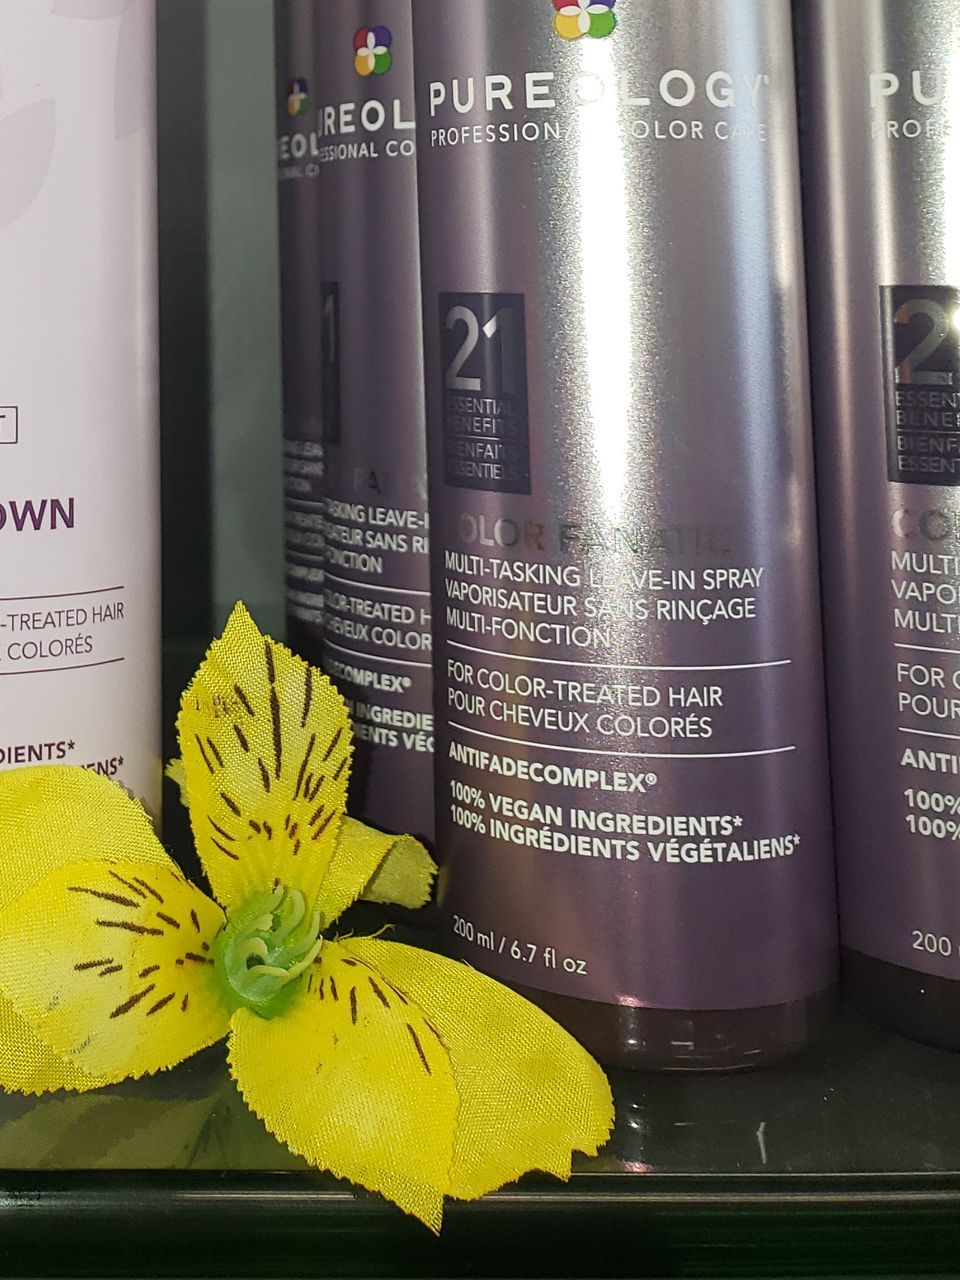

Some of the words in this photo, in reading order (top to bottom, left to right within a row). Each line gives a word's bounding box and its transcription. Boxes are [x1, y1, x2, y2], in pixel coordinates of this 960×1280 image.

[431, 121, 559, 147] PROFESSION
[631, 120, 704, 139] OLOR
[365, 531, 408, 553] SANS
[445, 550, 581, 587] MULTI-TASKING
[590, 569, 694, 590] LEAVE-IN
[703, 567, 763, 590] SPRAY
[445, 579, 577, 616] VAPORISATEUR
[584, 598, 648, 620] SANS
[657, 598, 756, 625] RINÇAGE
[890, 579, 960, 605] VAPO
[92, 602, 124, 623] HAIR
[446, 607, 611, 648] MULTI-FONCTION
[7, 634, 93, 660] COLORÉS
[448, 659, 474, 684] FOR
[477, 667, 661, 707] COLOR-TREATED
[669, 687, 723, 707] HAIR
[897, 663, 945, 688] FOR
[448, 688, 485, 717] POUR
[489, 700, 590, 733] CHEVEUX
[597, 711, 712, 738] COLORÉS
[898, 692, 960, 719] POUR
[450, 780, 485, 809] 100%
[489, 792, 562, 826] VEGAN
[450, 805, 486, 834] 100%
[490, 818, 639, 861] INGRÉDIENTS
[453, 915, 474, 942] 200
[477, 931, 494, 951] ml
[511, 941, 537, 963] 6.7
[543, 948, 558, 969] fl
[563, 957, 588, 975] oz
[912, 930, 952, 956] 200
